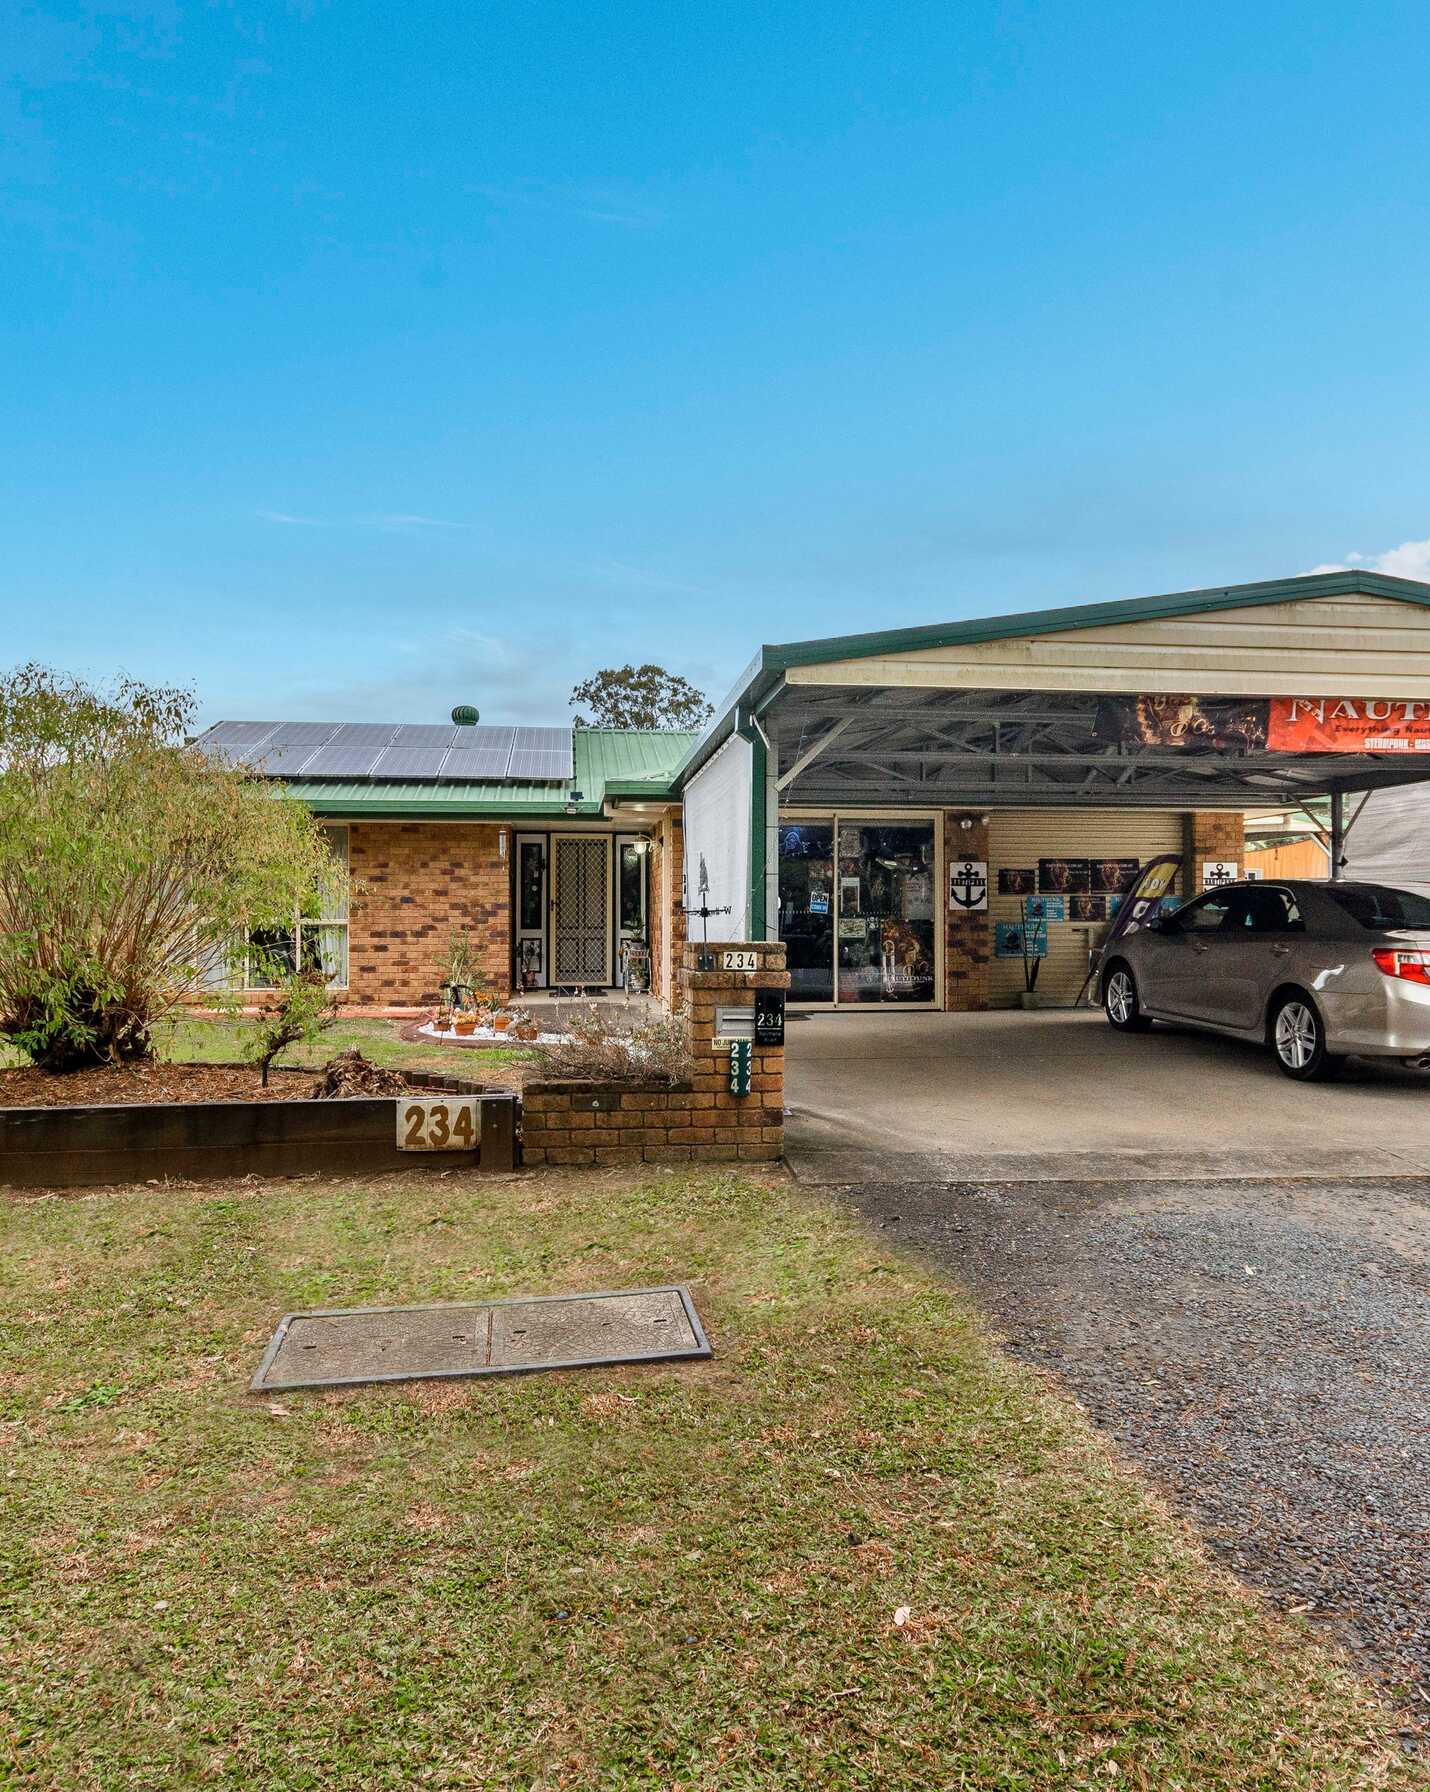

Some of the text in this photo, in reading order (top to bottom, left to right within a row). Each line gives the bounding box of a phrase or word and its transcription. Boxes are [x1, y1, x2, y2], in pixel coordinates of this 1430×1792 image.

[1335, 725, 1399, 735] Everything
[726, 954, 755, 969] 234
[757, 1013, 782, 1026] 234
[405, 1105, 474, 1147] 234
